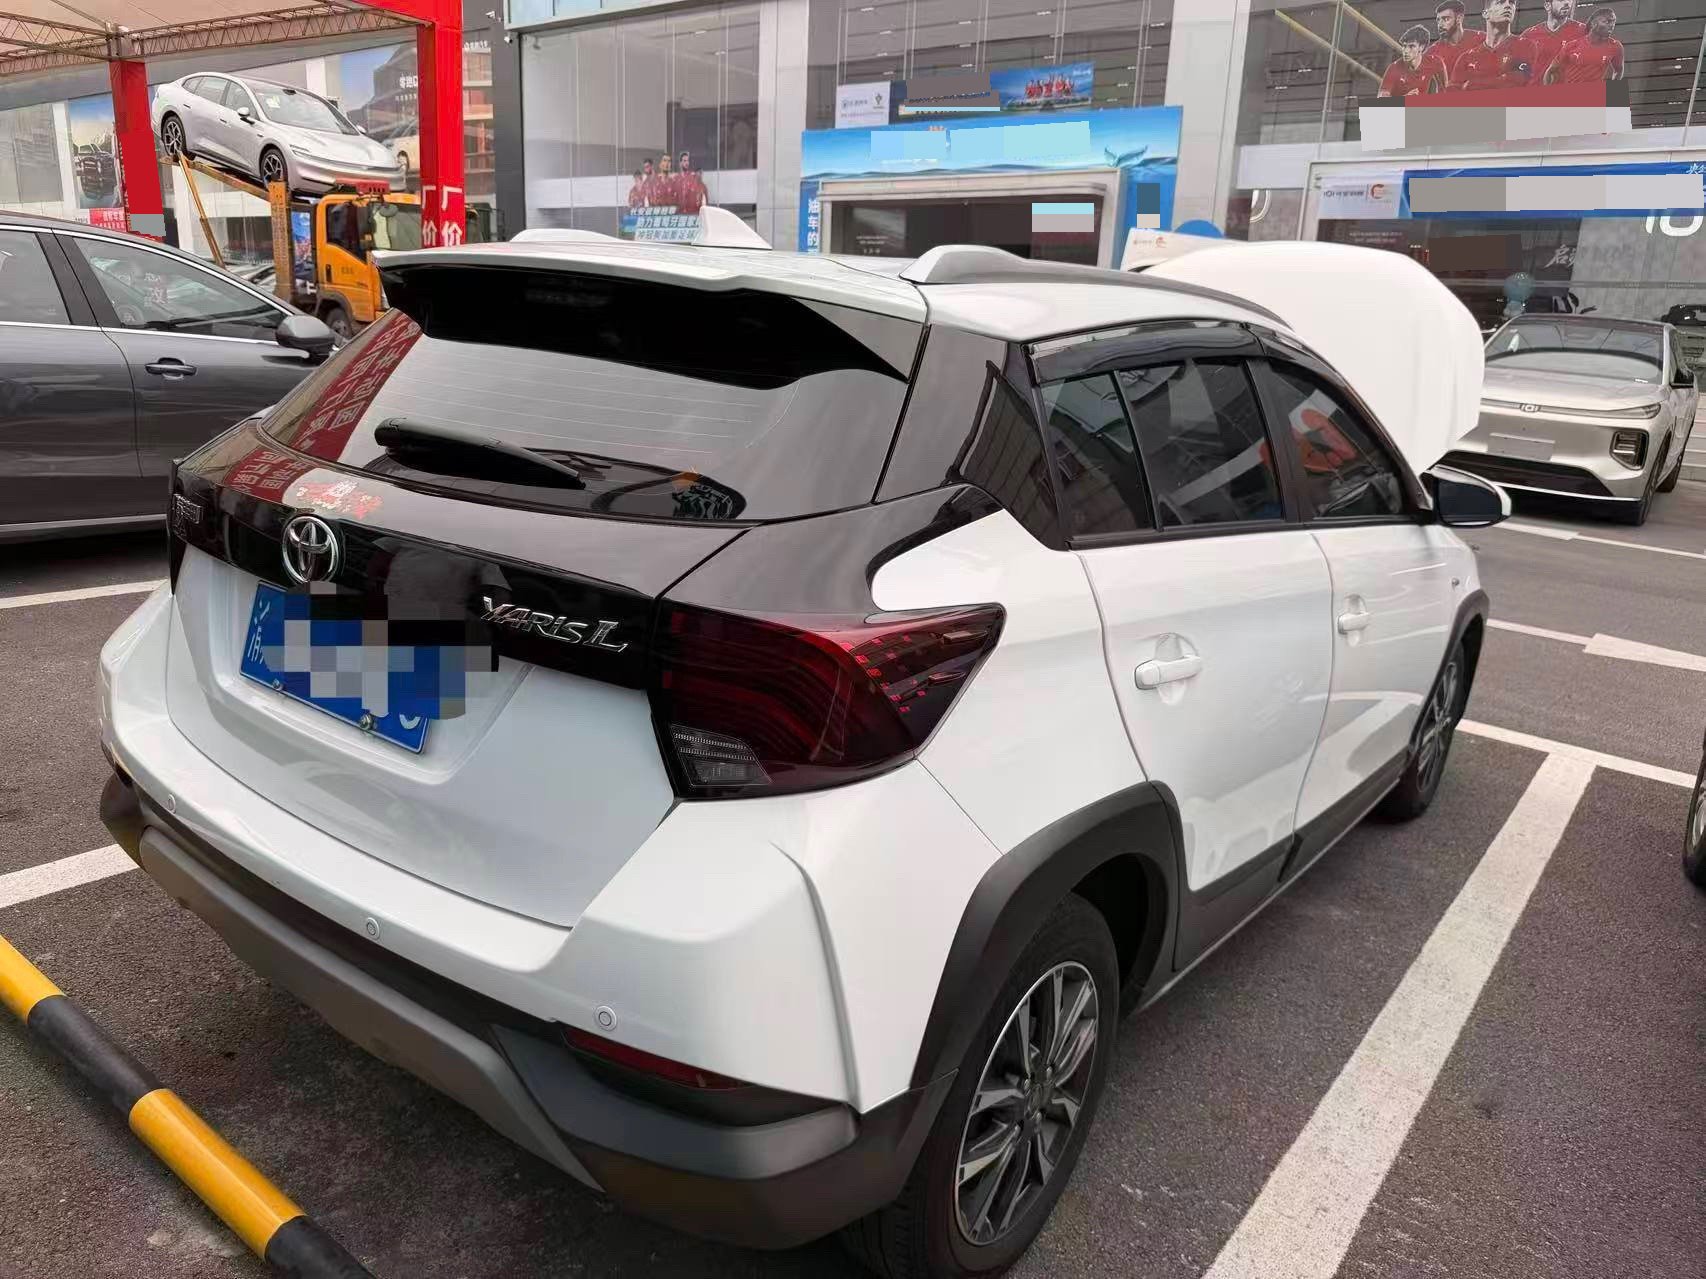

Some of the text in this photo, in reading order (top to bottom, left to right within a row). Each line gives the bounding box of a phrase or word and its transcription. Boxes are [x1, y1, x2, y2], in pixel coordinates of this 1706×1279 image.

[422, 185, 437, 247] 厂价
[441, 185, 463, 247] 厂价
[583, 620, 628, 653] L
